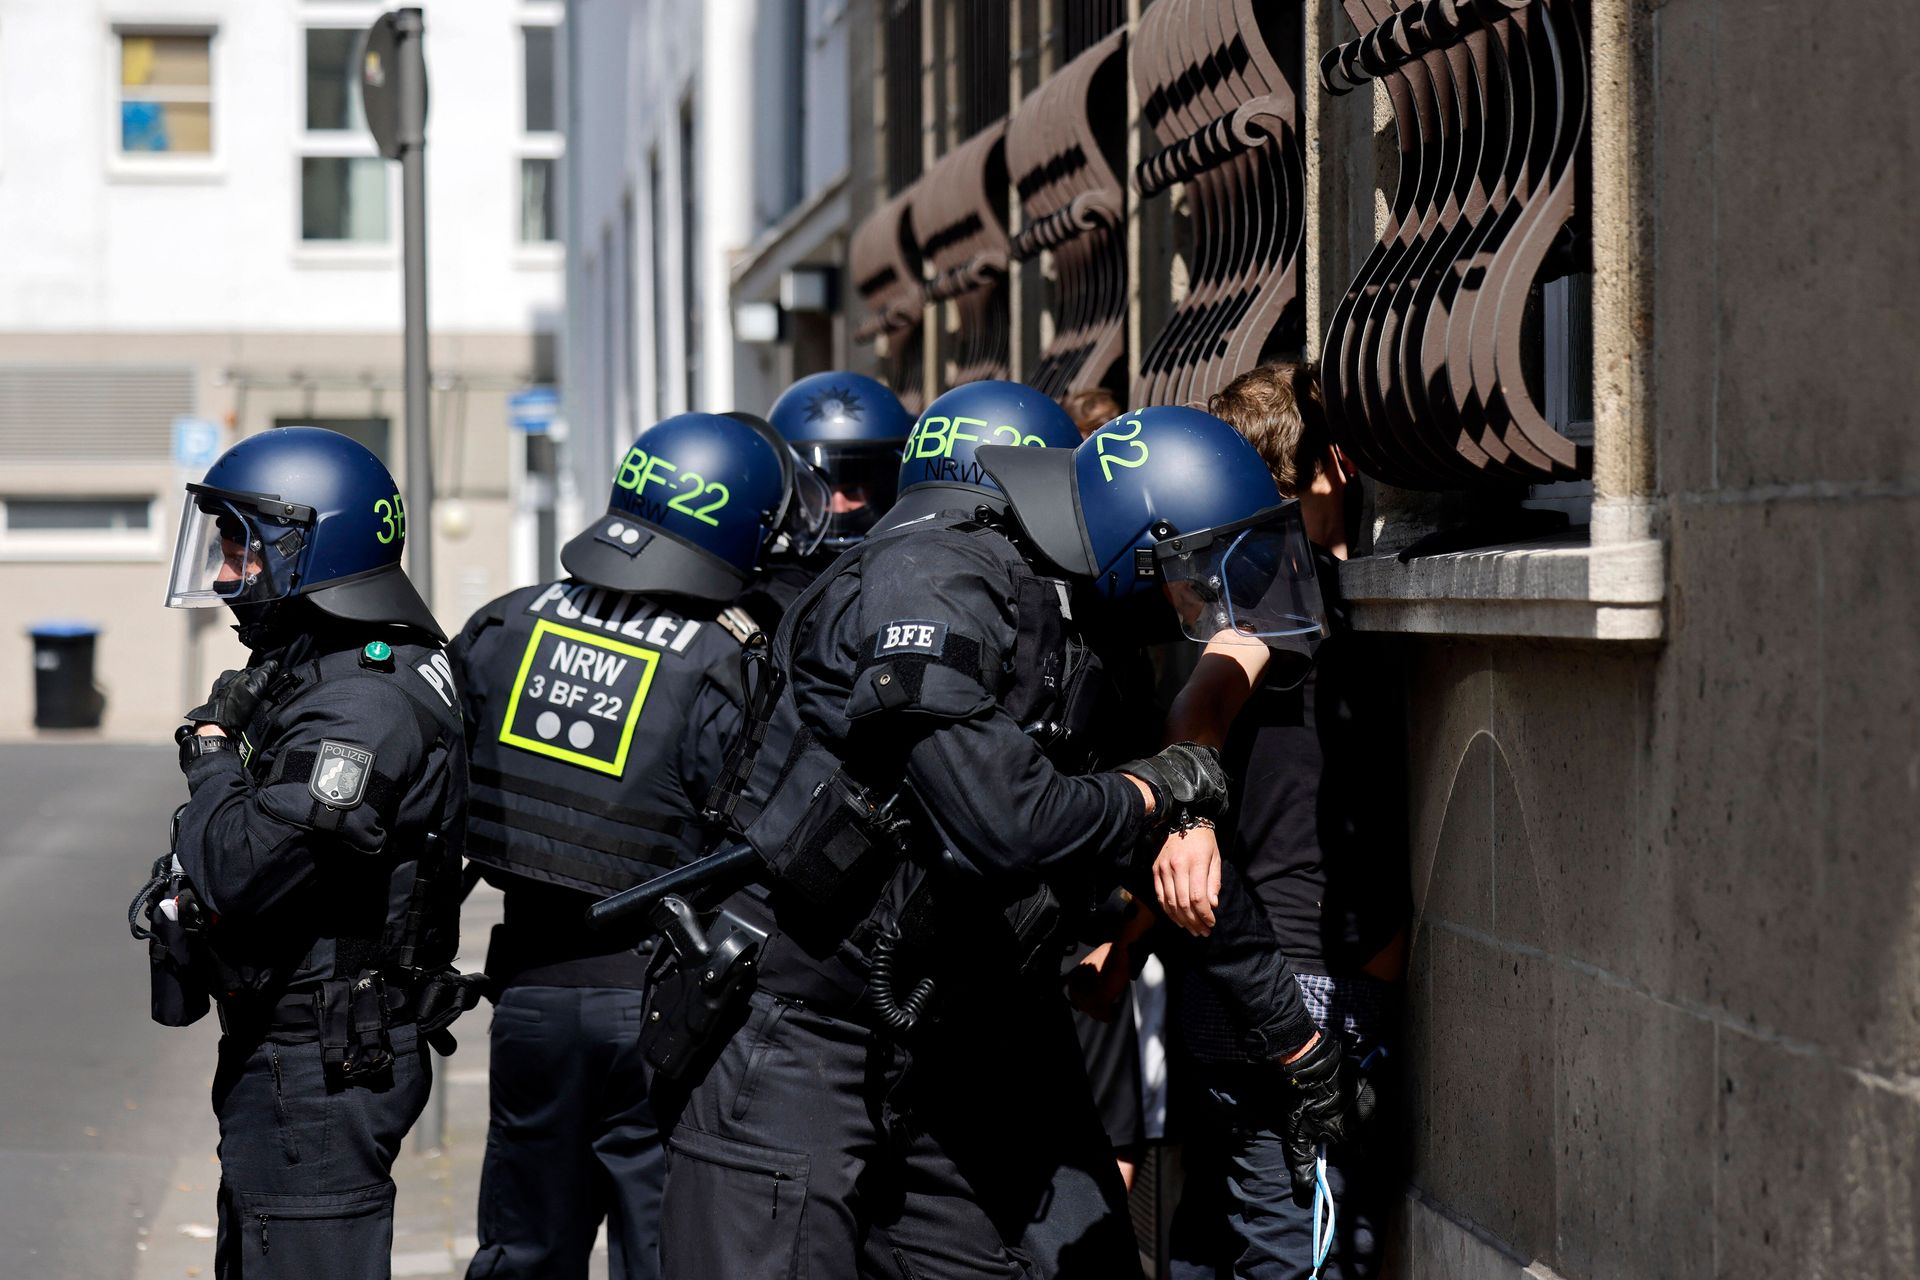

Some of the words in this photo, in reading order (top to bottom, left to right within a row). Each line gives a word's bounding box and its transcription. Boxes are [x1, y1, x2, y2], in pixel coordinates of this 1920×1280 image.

[529, 583, 701, 653] POLIZEI
[883, 625, 935, 649] BFE
[417, 649, 457, 707] PO
[550, 641, 628, 687] NRW
[528, 675, 546, 698] 3
[549, 680, 588, 708] BF
[588, 692, 623, 721] 22
[325, 745, 369, 765] POLIZEI
